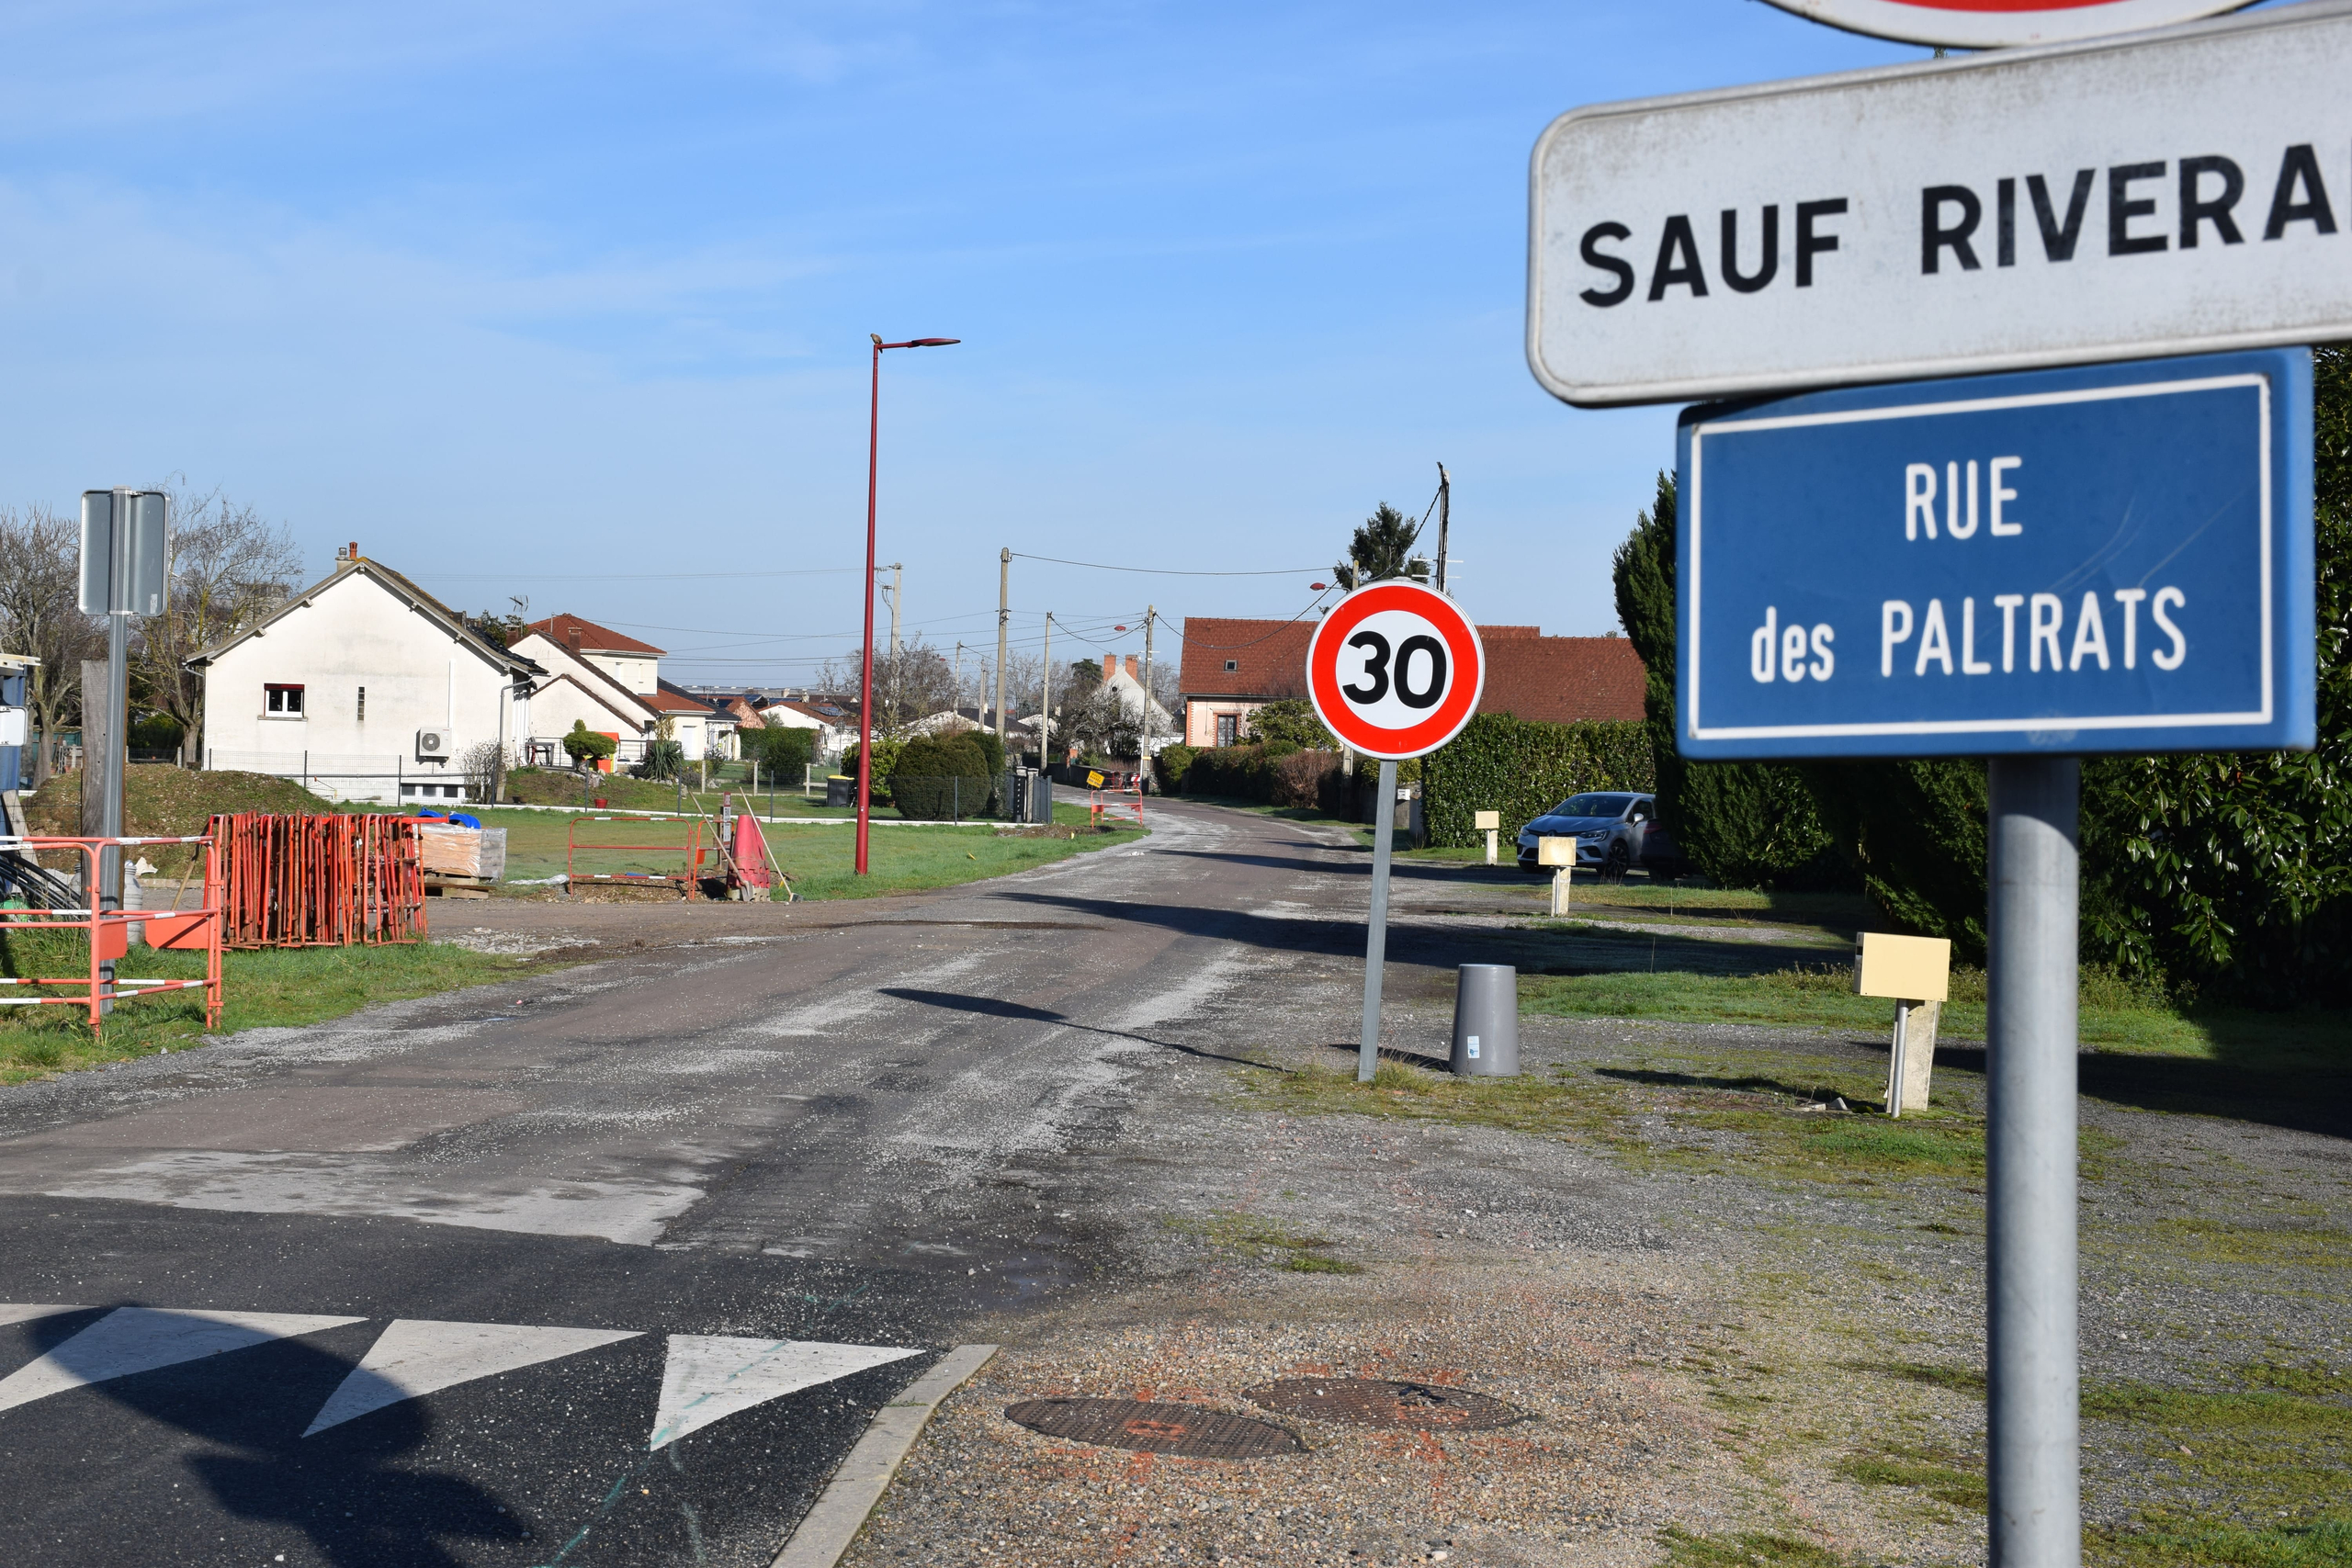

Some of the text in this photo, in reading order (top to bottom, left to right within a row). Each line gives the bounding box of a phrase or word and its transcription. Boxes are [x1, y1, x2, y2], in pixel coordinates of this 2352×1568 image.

[1578, 141, 2352, 309] SAUF RIVERA
[1905, 456, 2023, 542] RUE
[1341, 630, 1447, 709] 30
[1750, 586, 2187, 684] des PALTRATS
